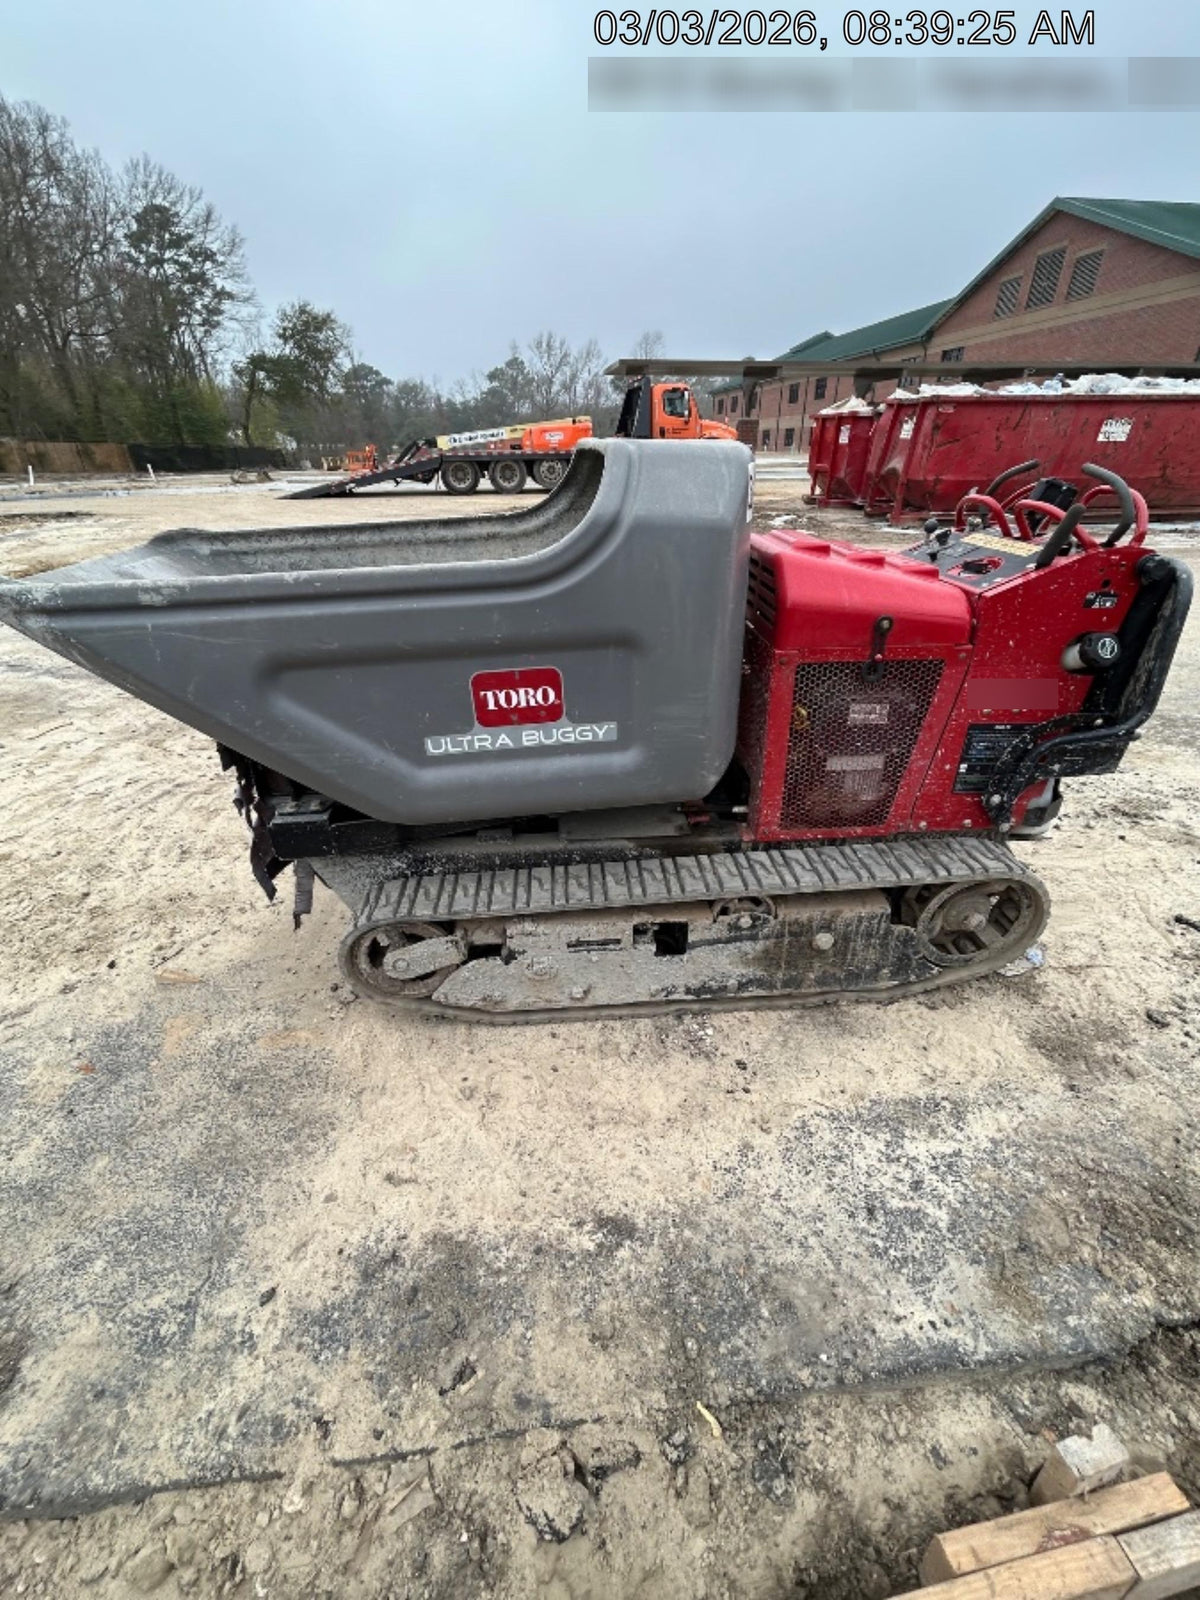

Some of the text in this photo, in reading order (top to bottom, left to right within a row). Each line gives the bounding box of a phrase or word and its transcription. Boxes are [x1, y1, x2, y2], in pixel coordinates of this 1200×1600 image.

[480, 686, 556, 710] TORO
[427, 725, 608, 753] ULTRA BUGGY
